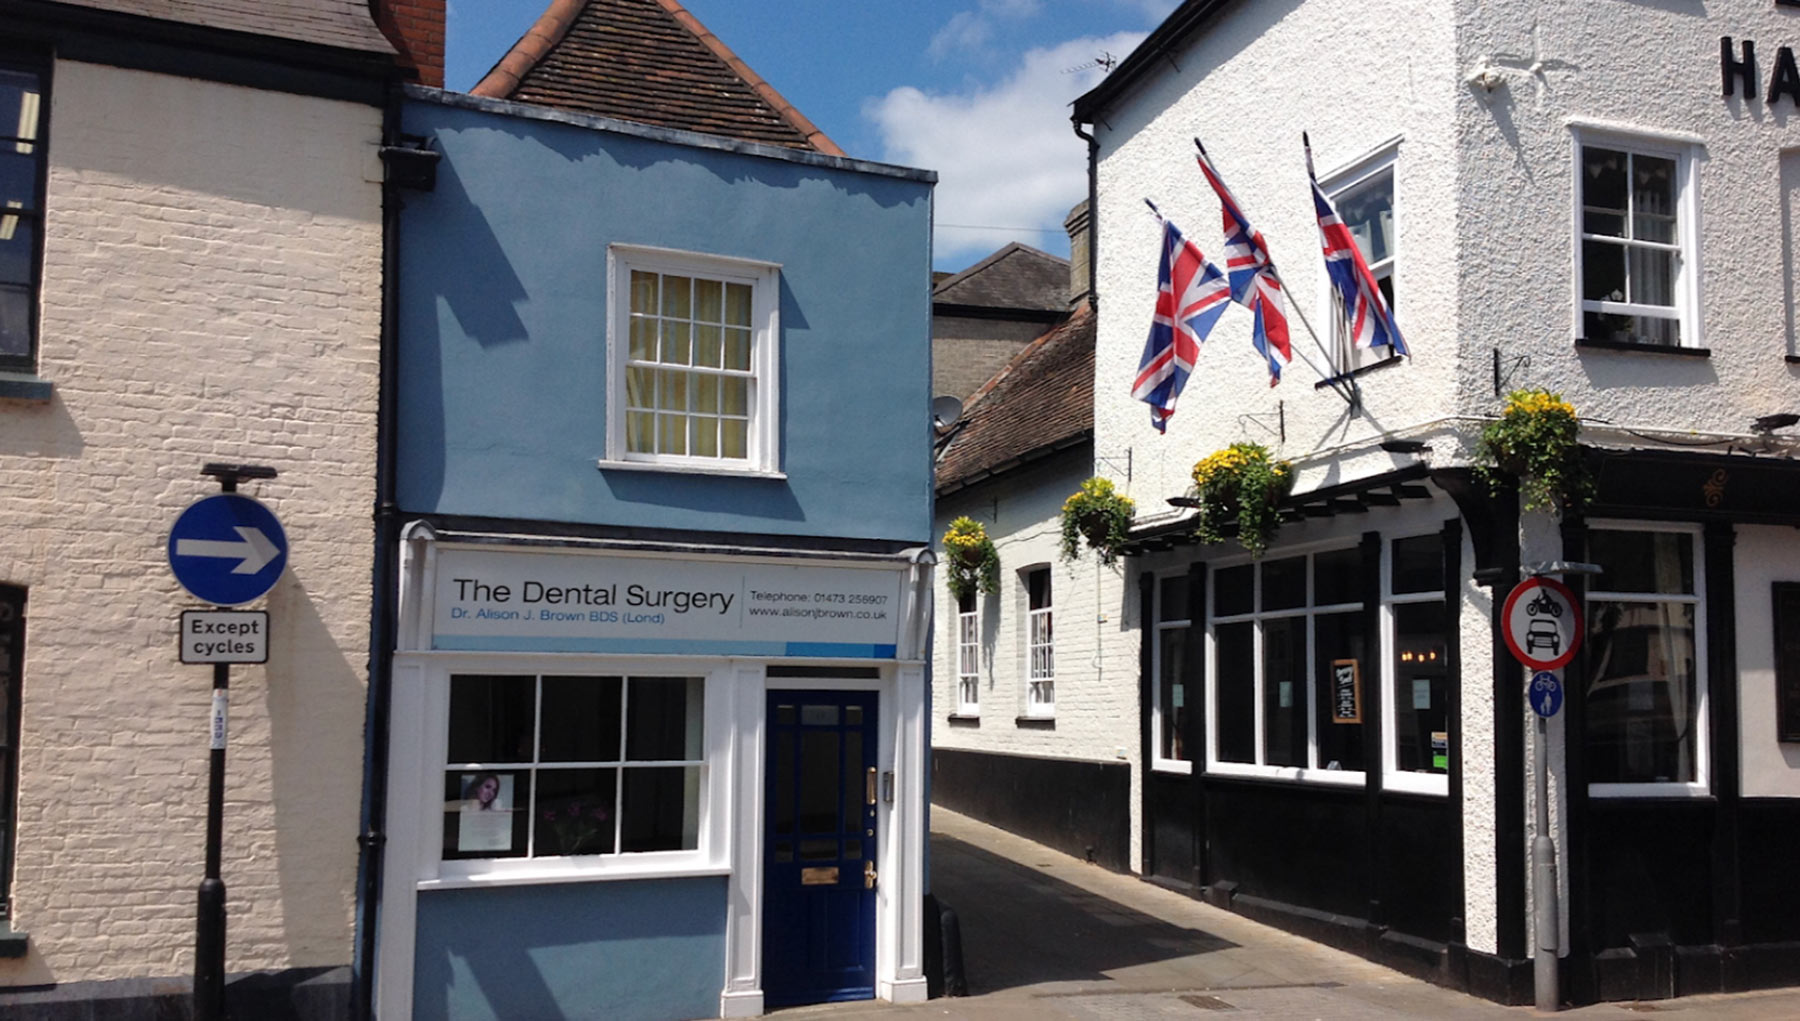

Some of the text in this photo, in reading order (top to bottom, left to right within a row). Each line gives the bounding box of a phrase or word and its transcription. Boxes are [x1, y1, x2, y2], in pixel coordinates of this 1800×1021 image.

[453, 579, 734, 615] The Dental Surgery
[750, 590, 811, 602] Telephone:
[814, 592, 845, 604] 01473
[451, 607, 665, 624] Dr. Alison J. Brown BDS (Lond)
[749, 608, 887, 619] www.alisonjbrown.co.uk
[191, 619, 259, 636] Except
[193, 639, 255, 656] cycles
